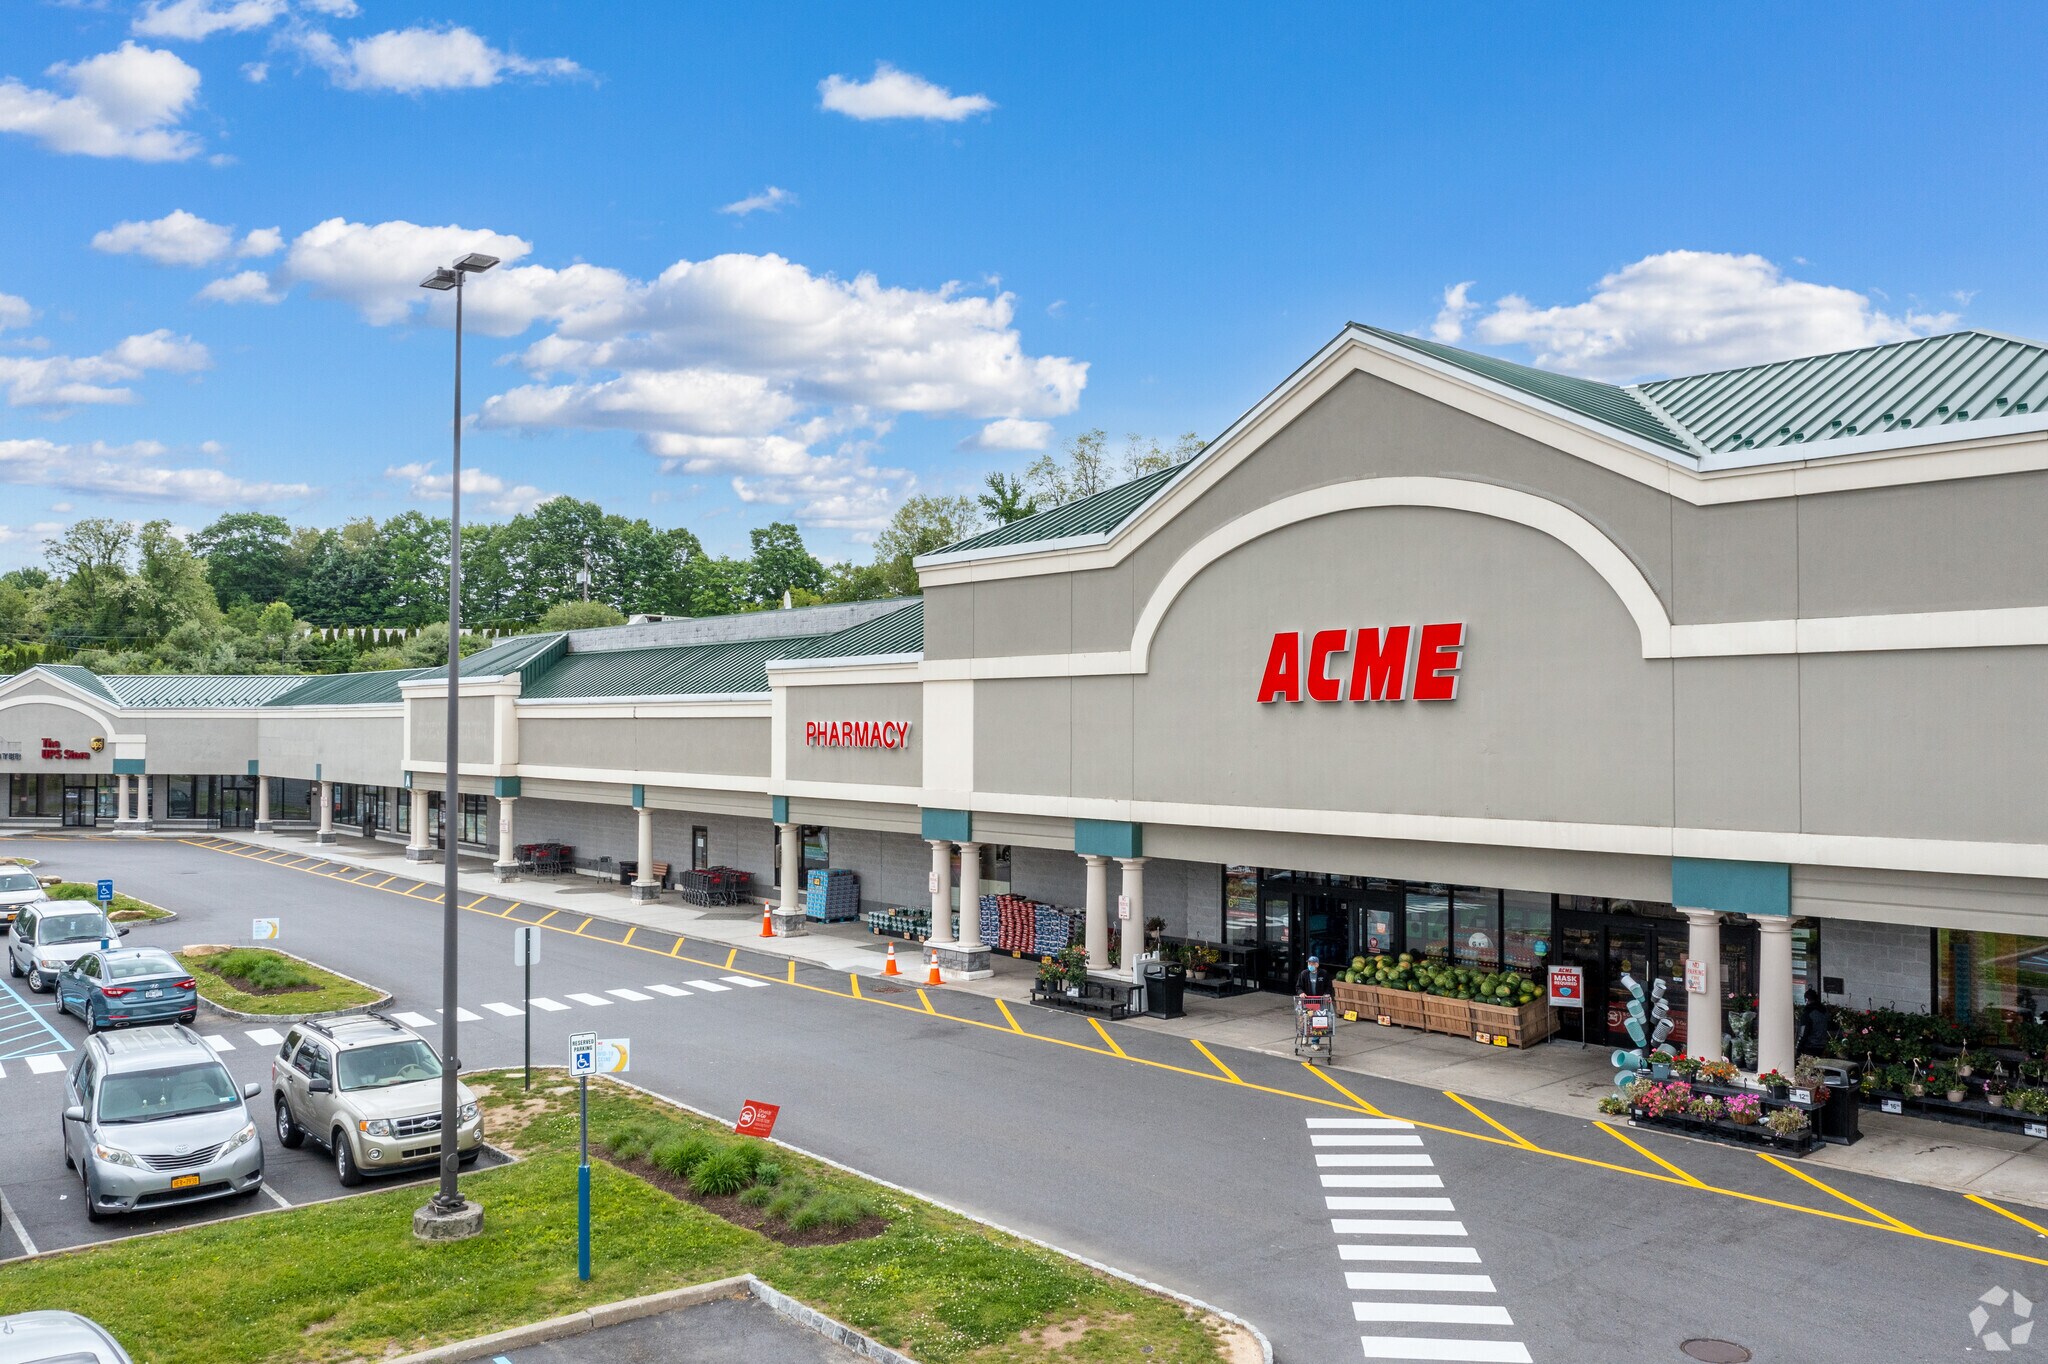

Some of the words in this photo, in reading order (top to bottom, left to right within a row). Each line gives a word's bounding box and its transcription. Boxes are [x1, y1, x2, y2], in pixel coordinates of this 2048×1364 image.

[1256, 622, 1468, 704] ACME
[805, 720, 911, 749] PHARMACY
[41, 738, 61, 749] The
[41, 749, 62, 760] UPS
[64, 749, 91, 760] Store
[1553, 974, 1577, 982] MASK
